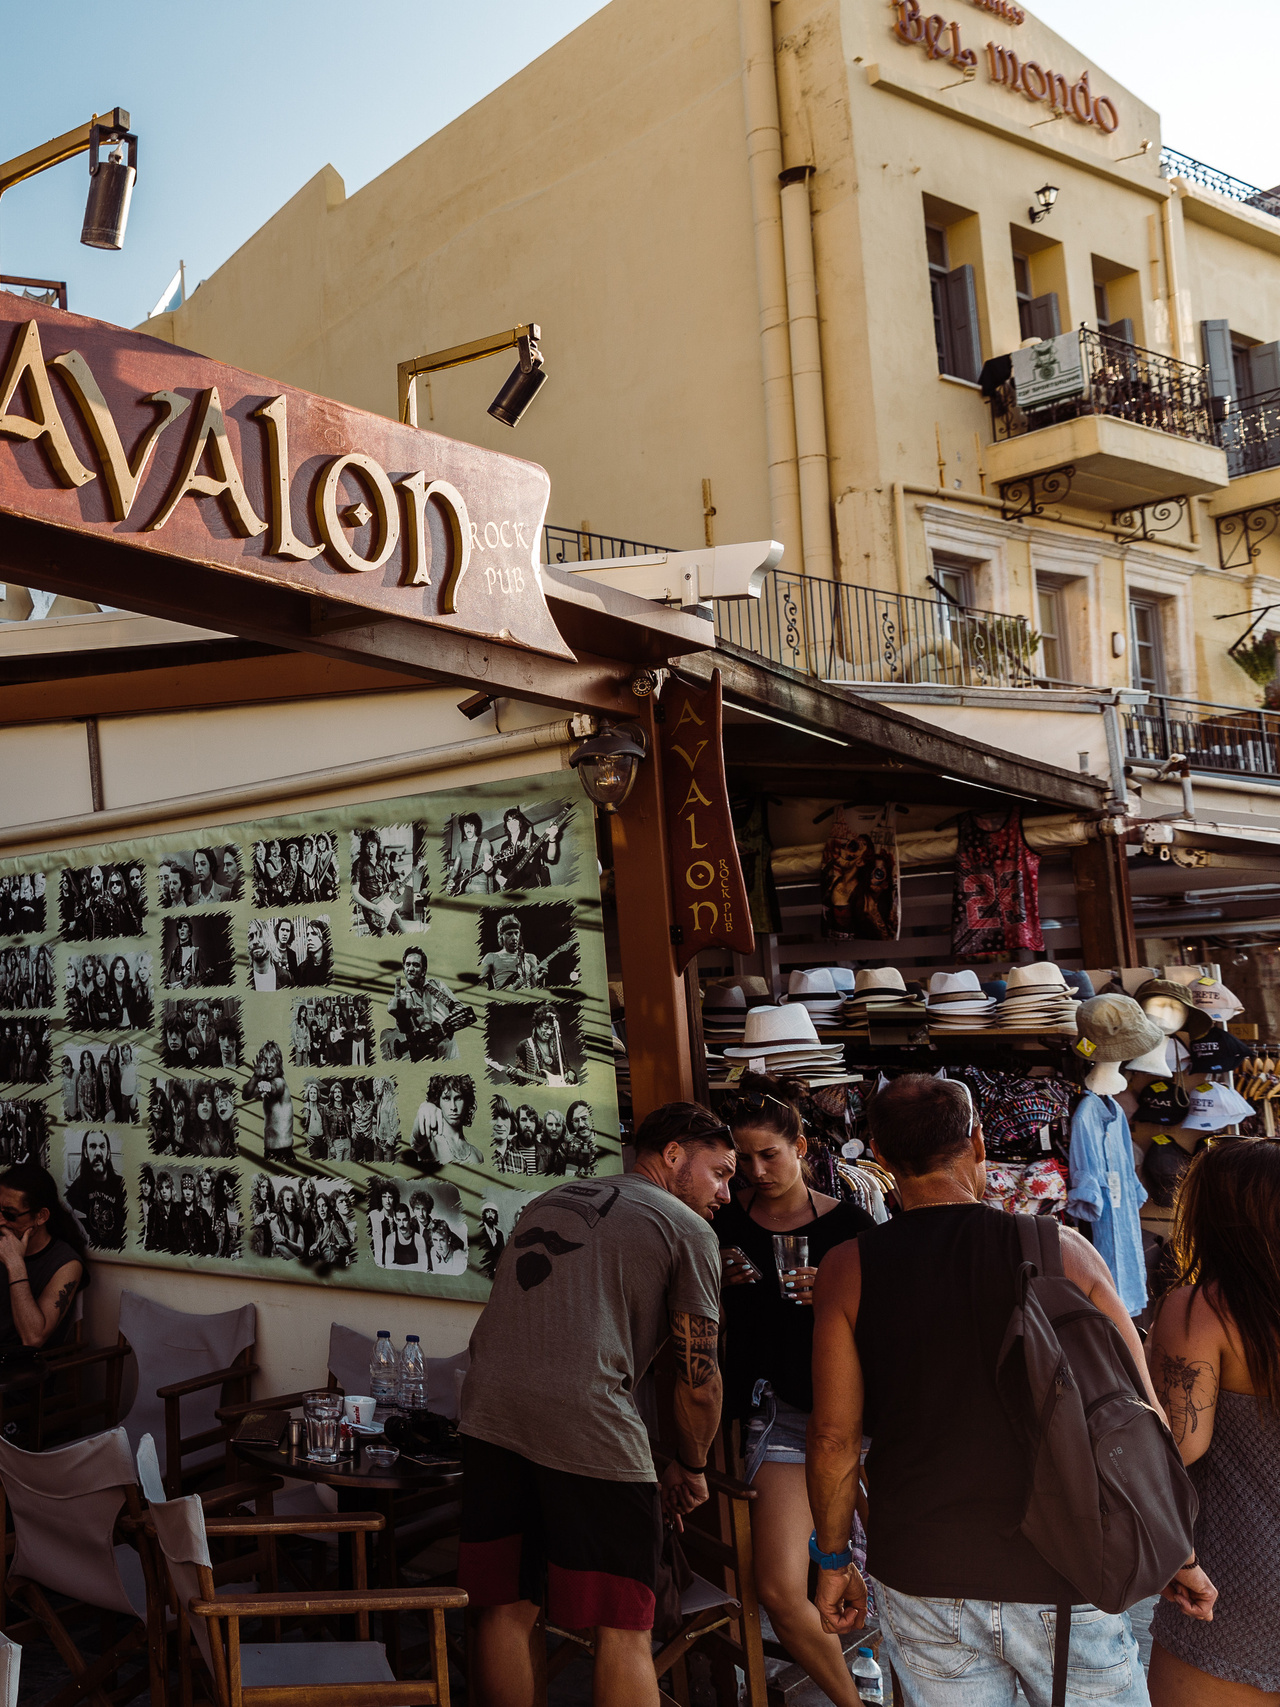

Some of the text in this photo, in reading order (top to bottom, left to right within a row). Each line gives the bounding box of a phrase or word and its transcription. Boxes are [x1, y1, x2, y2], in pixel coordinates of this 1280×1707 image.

[470, 520, 530, 552] ROCK
[483, 566, 526, 595] PUB
[671, 698, 719, 935] AVALON
[718, 858, 733, 932] ROCK PUB
